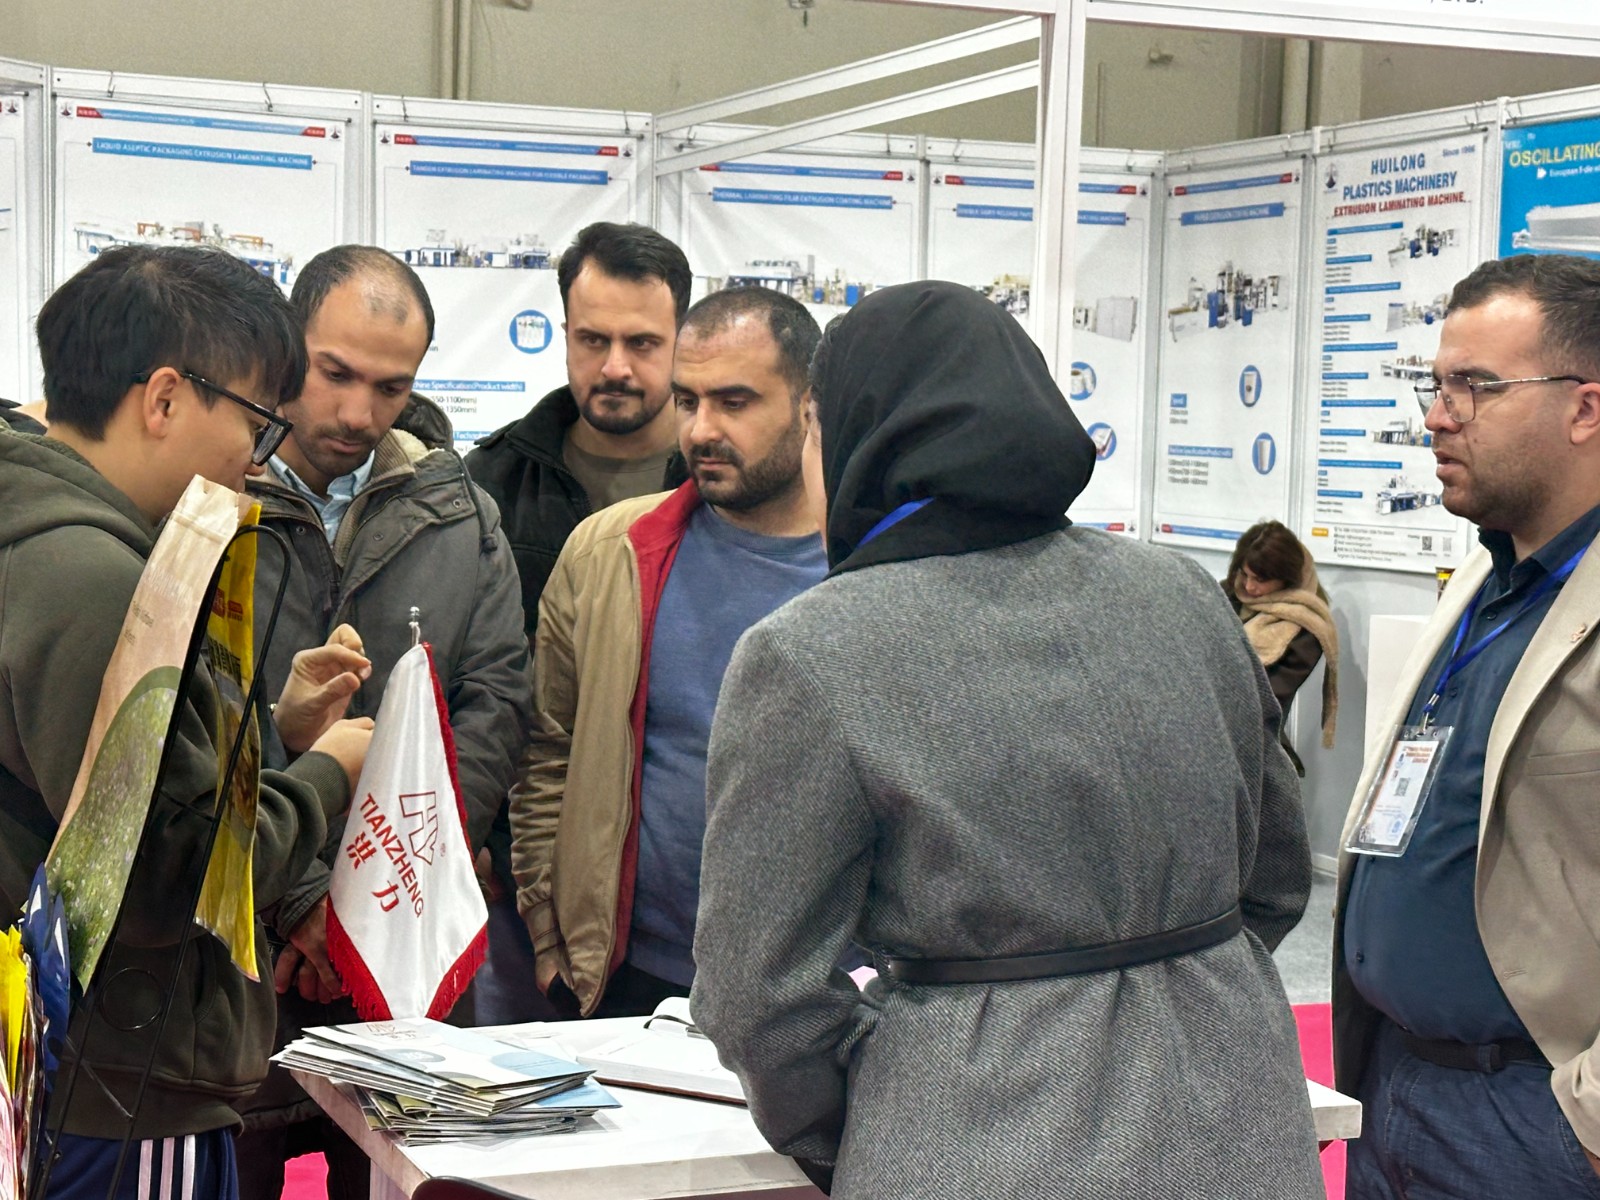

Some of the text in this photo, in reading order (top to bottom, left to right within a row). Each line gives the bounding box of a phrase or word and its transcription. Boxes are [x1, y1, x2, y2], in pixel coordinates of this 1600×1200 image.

[1371, 152, 1426, 175] HUILONG
[1343, 171, 1458, 201] PLASTICS MACHINERY
[1334, 191, 1465, 218] EXTRUSION LAMINATING MACHINE
[359, 792, 424, 918] TIANZHENG
